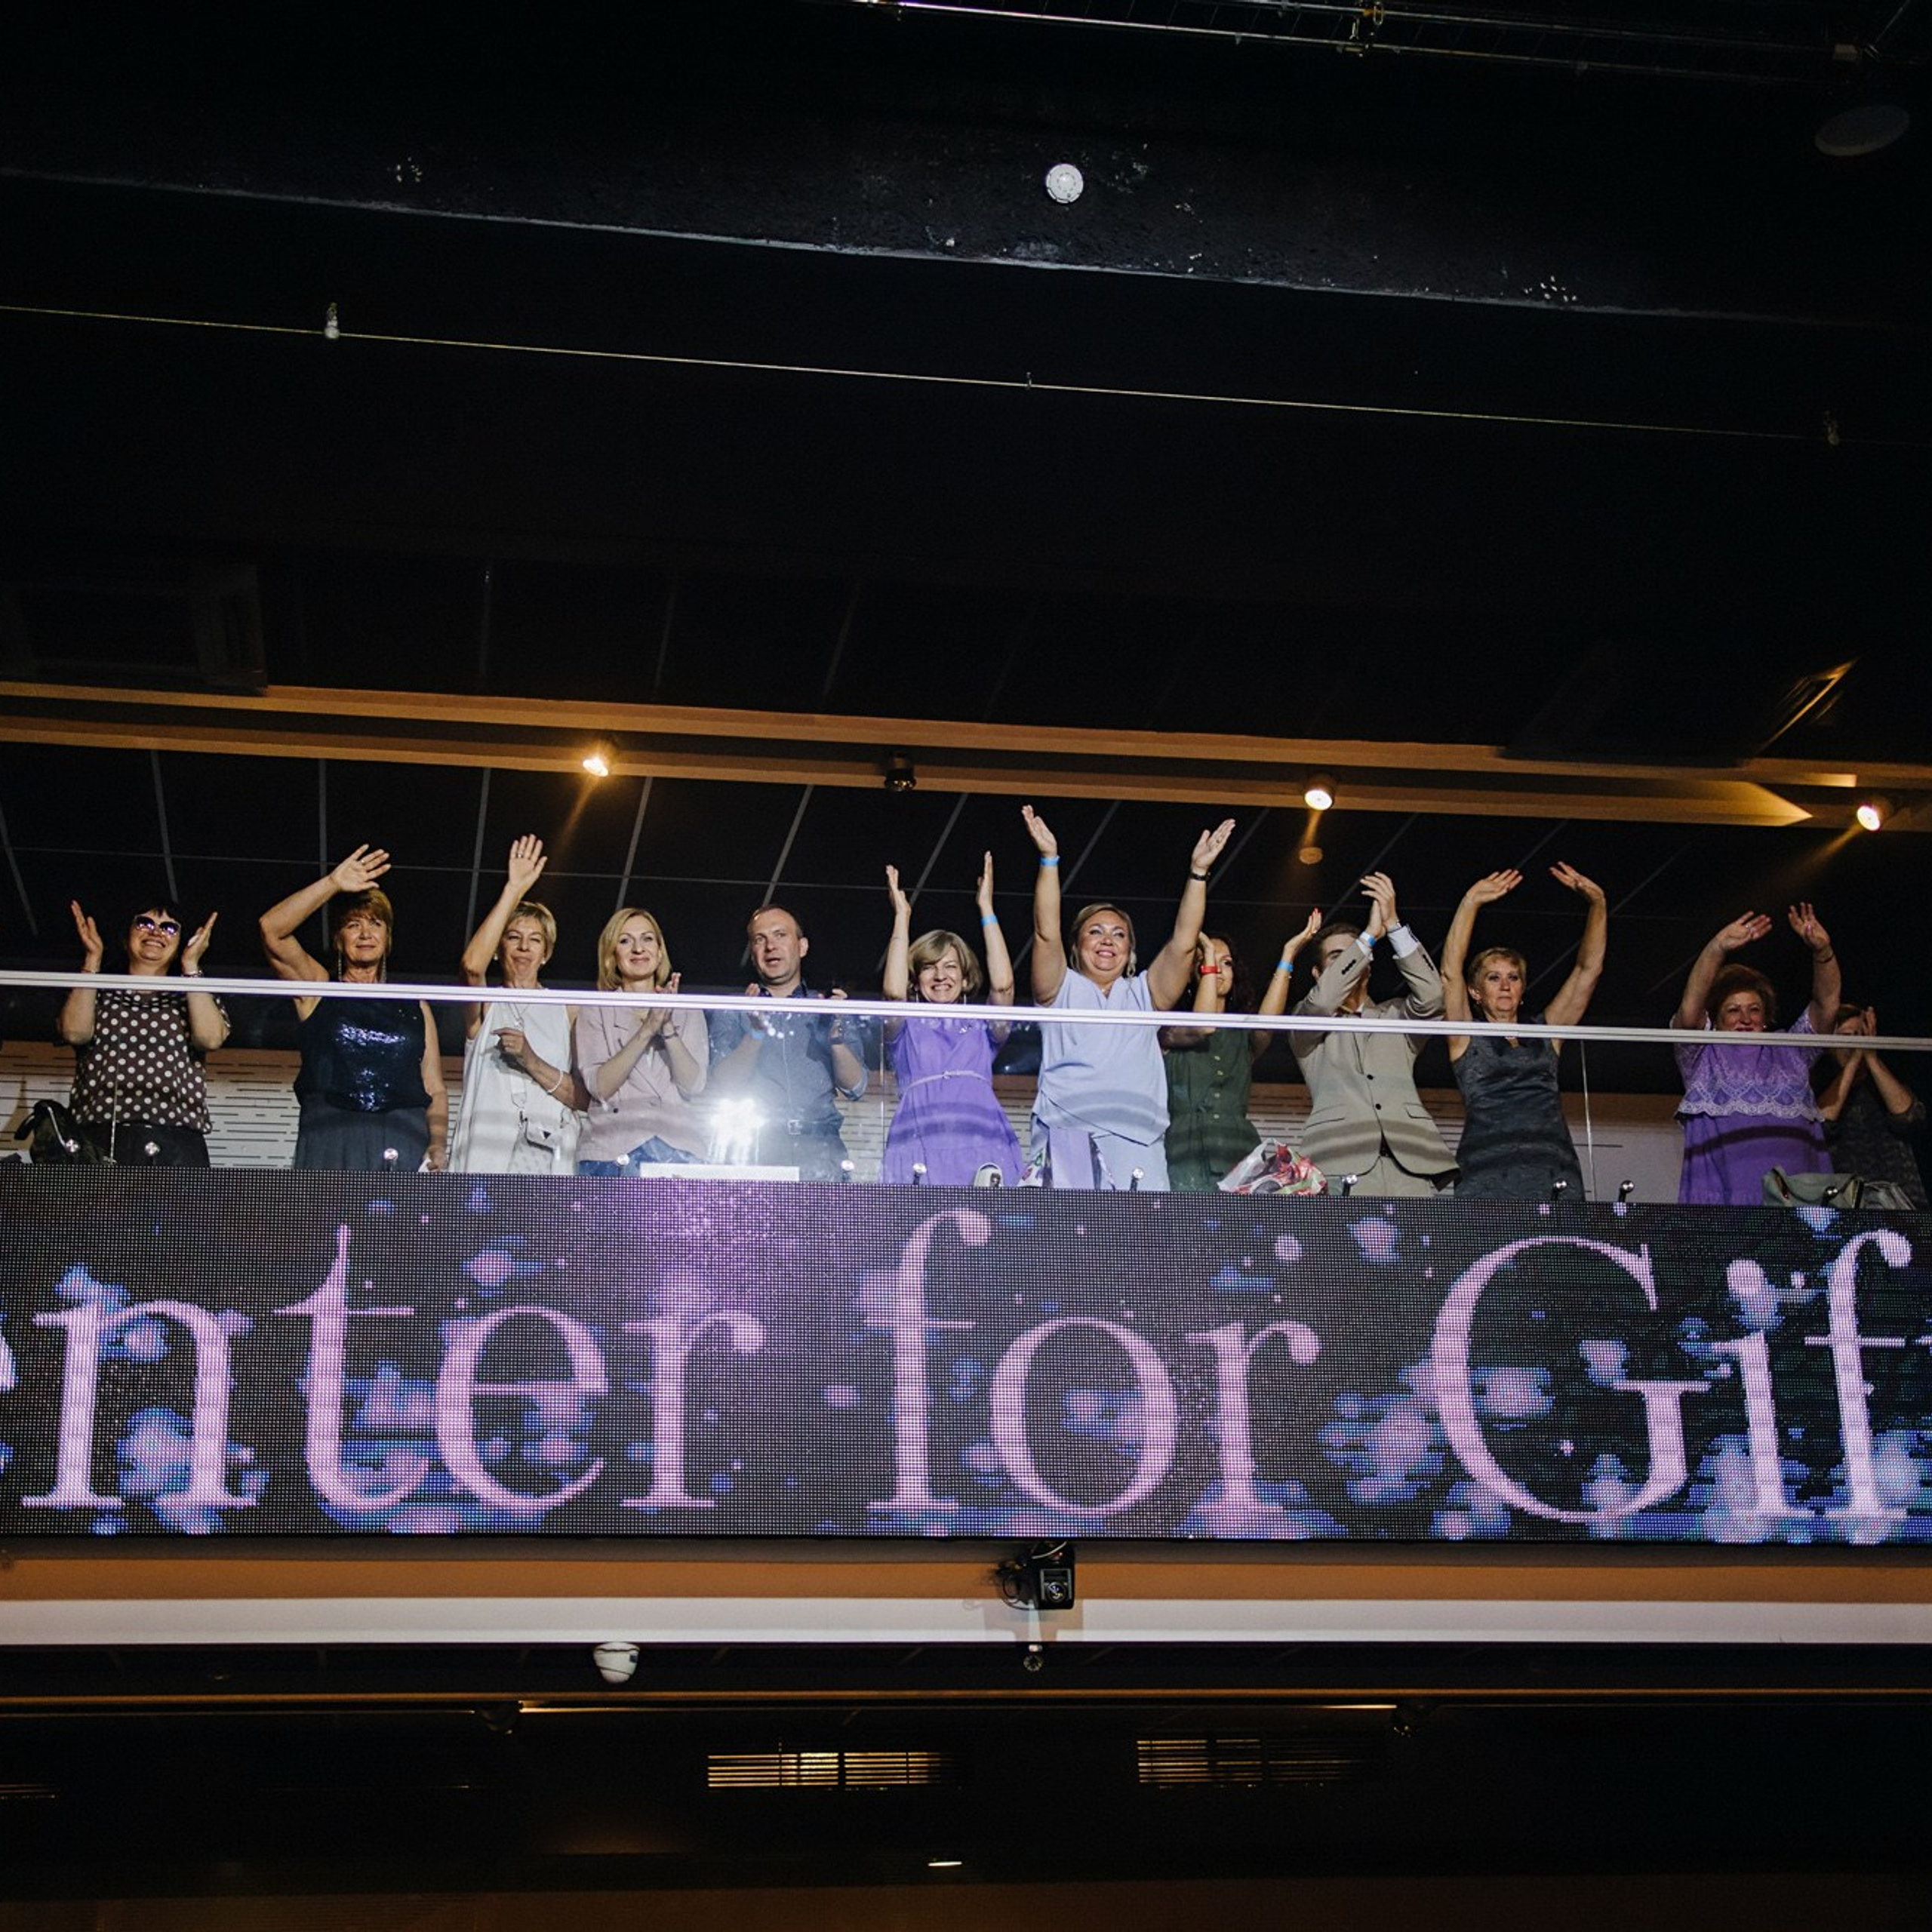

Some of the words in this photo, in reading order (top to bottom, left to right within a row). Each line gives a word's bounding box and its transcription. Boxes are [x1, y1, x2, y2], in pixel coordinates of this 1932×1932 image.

[0, 1224, 764, 1512] nter
[865, 1208, 1322, 1515] for
[1430, 1229, 1932, 1524] Gif
